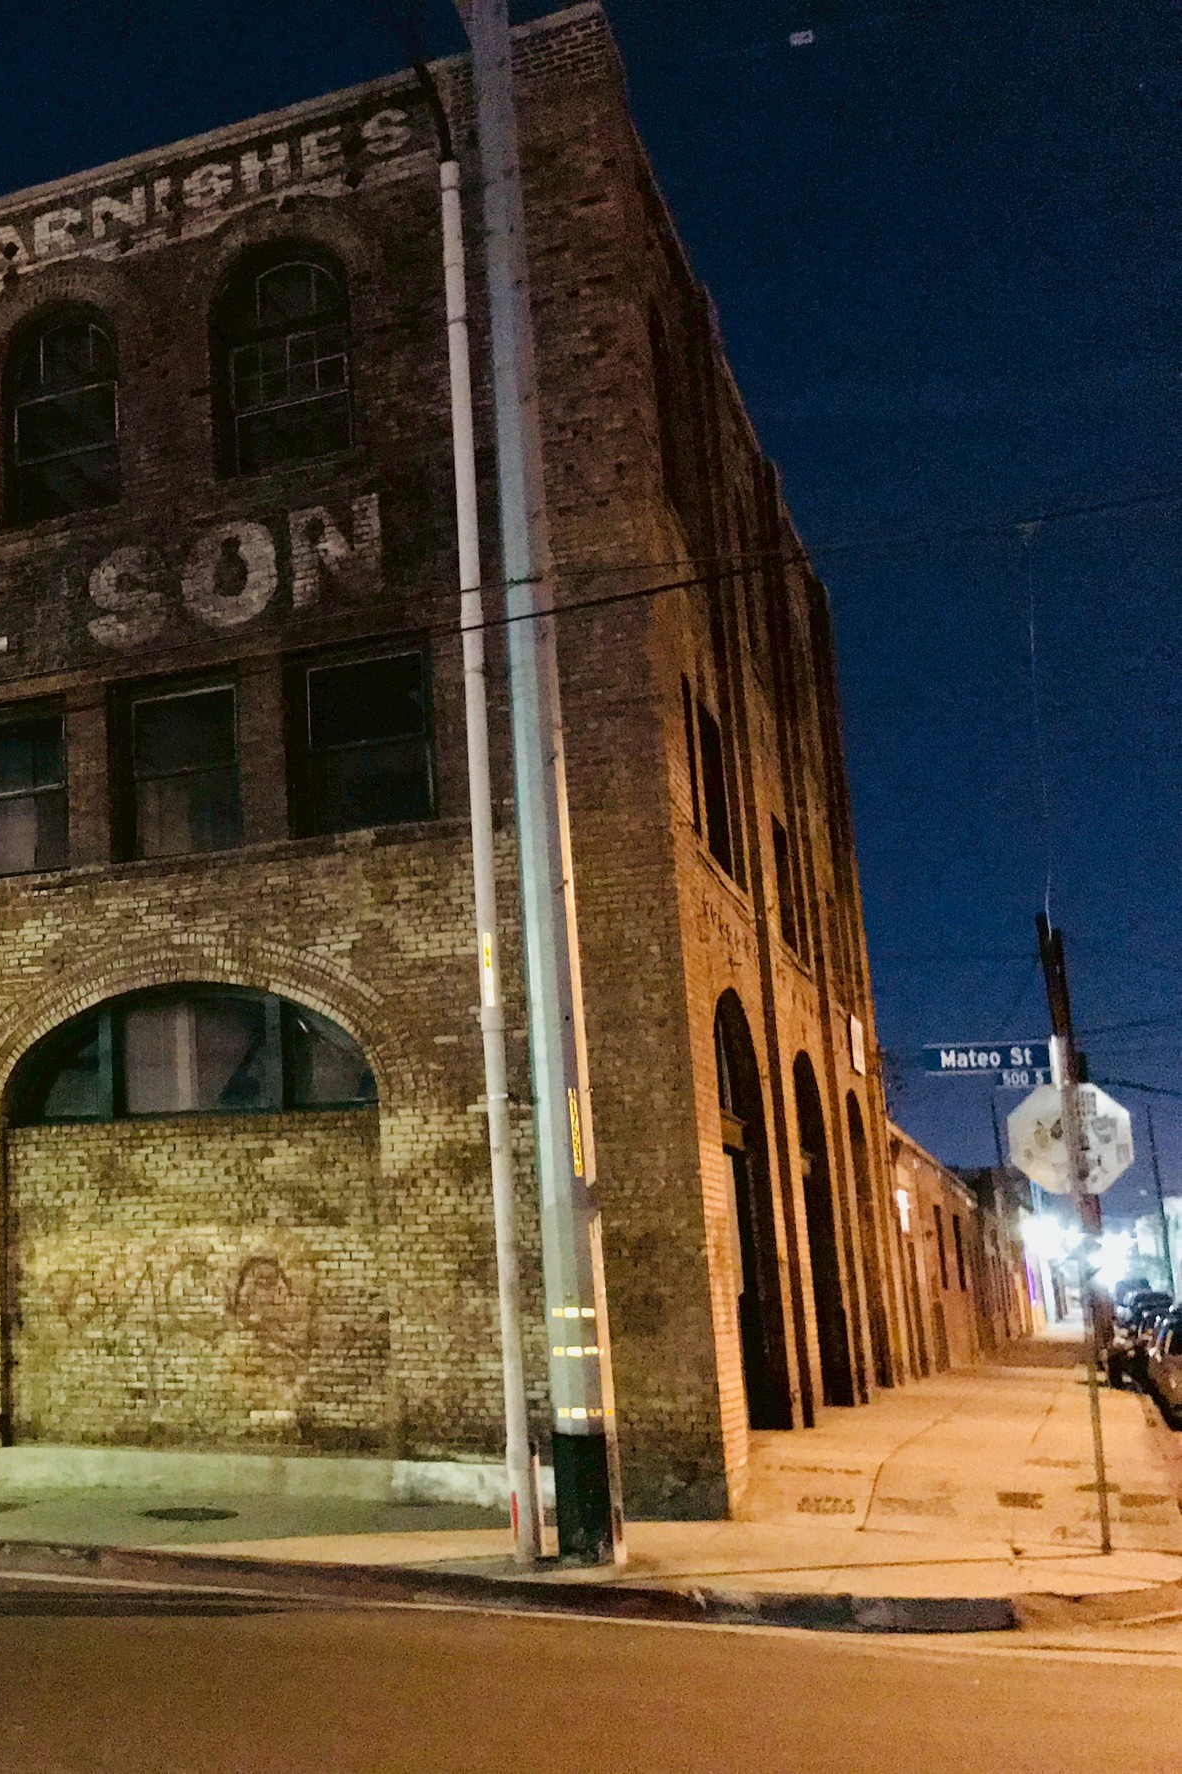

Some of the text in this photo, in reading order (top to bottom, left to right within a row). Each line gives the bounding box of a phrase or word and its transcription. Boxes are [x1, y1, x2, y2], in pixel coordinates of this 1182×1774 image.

[86, 492, 383, 649] SON
[940, 1047, 1033, 1068] Mateo St
[1002, 1071, 1029, 1085] 500
